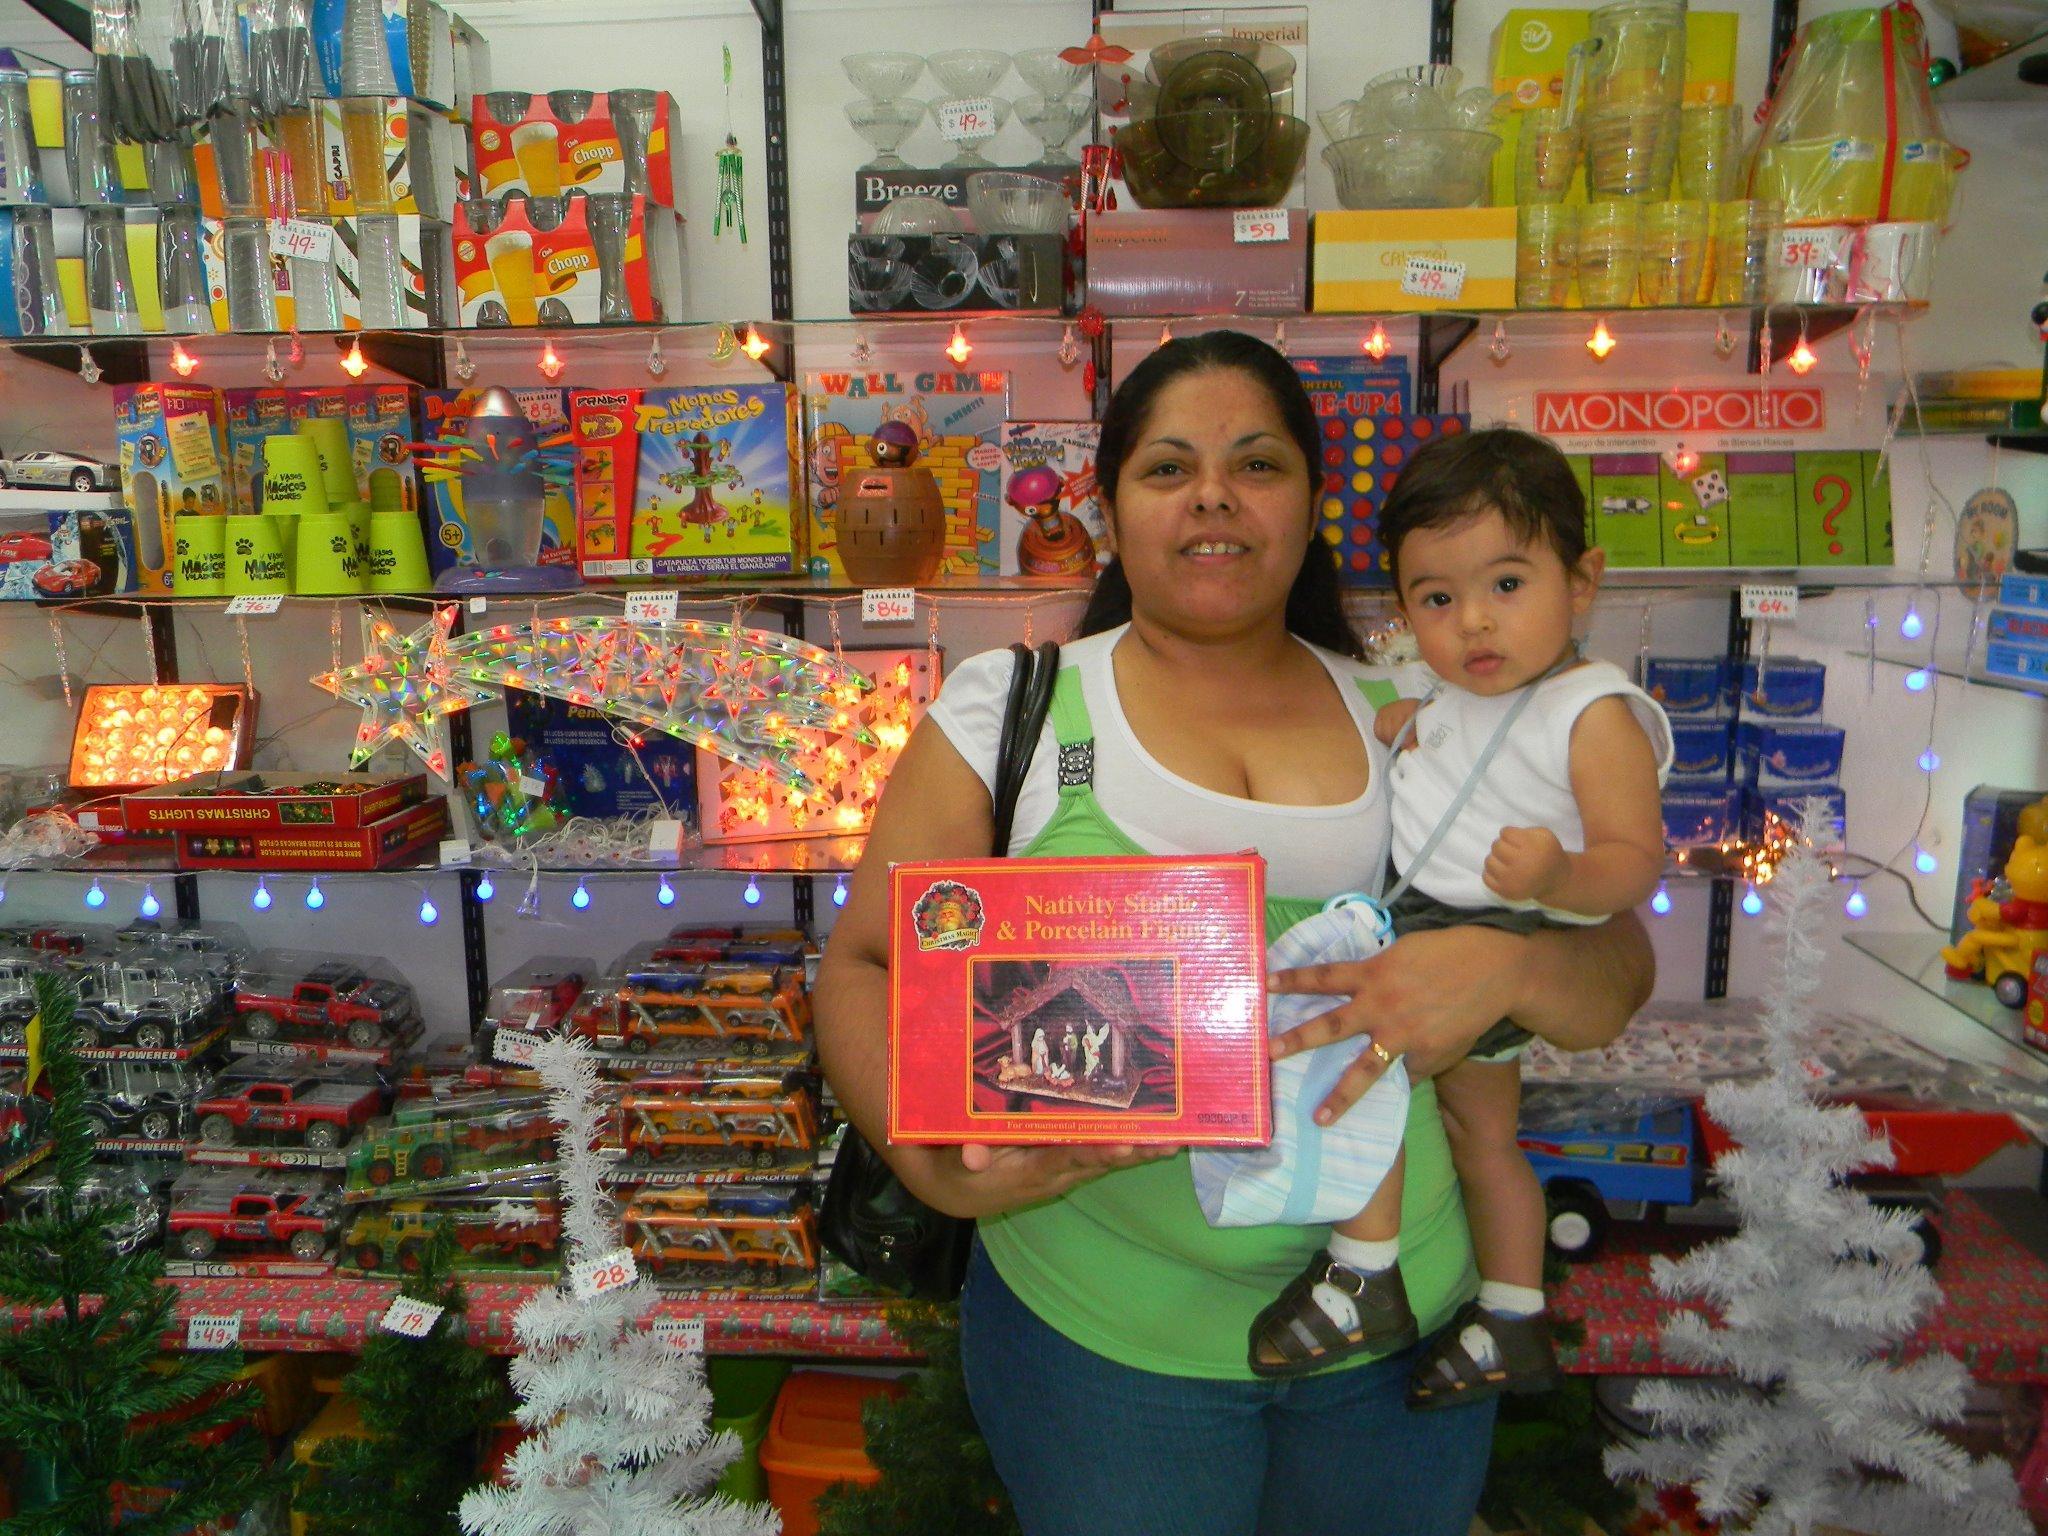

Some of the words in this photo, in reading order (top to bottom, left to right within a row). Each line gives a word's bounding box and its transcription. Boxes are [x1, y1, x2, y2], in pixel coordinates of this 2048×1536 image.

[1232, 26, 1301, 42] Imperial
[331, 145, 343, 180] CAPRI
[573, 145, 614, 165] Chopp
[864, 176, 959, 202] Breeze
[1249, 223, 1276, 239] 59
[548, 254, 590, 275] Chopp
[819, 373, 904, 399] WALL
[576, 394, 629, 408] PANDA
[668, 389, 739, 417] Monos
[633, 395, 766, 437] Trepadores
[1541, 392, 1820, 431] MONOPOLIO
[698, 557, 722, 565] TODOS
[723, 556, 737, 564] TUS
[765, 555, 787, 563] HACIA
[149, 808, 194, 820] LIGHTS
[196, 808, 271, 820] CHRISTMAS
[1024, 894, 1117, 919] Nativity
[996, 920, 1017, 942] &
[1025, 919, 1133, 941] Porcelain
[118, 1049, 177, 1061] POWERED
[1007, 1121, 1022, 1131] For
[1024, 1120, 1076, 1131] ornamental
[1077, 1121, 1120, 1133] purposes
[126, 1141, 184, 1151] POWERED
[605, 1171, 697, 1184] Hot-truck
